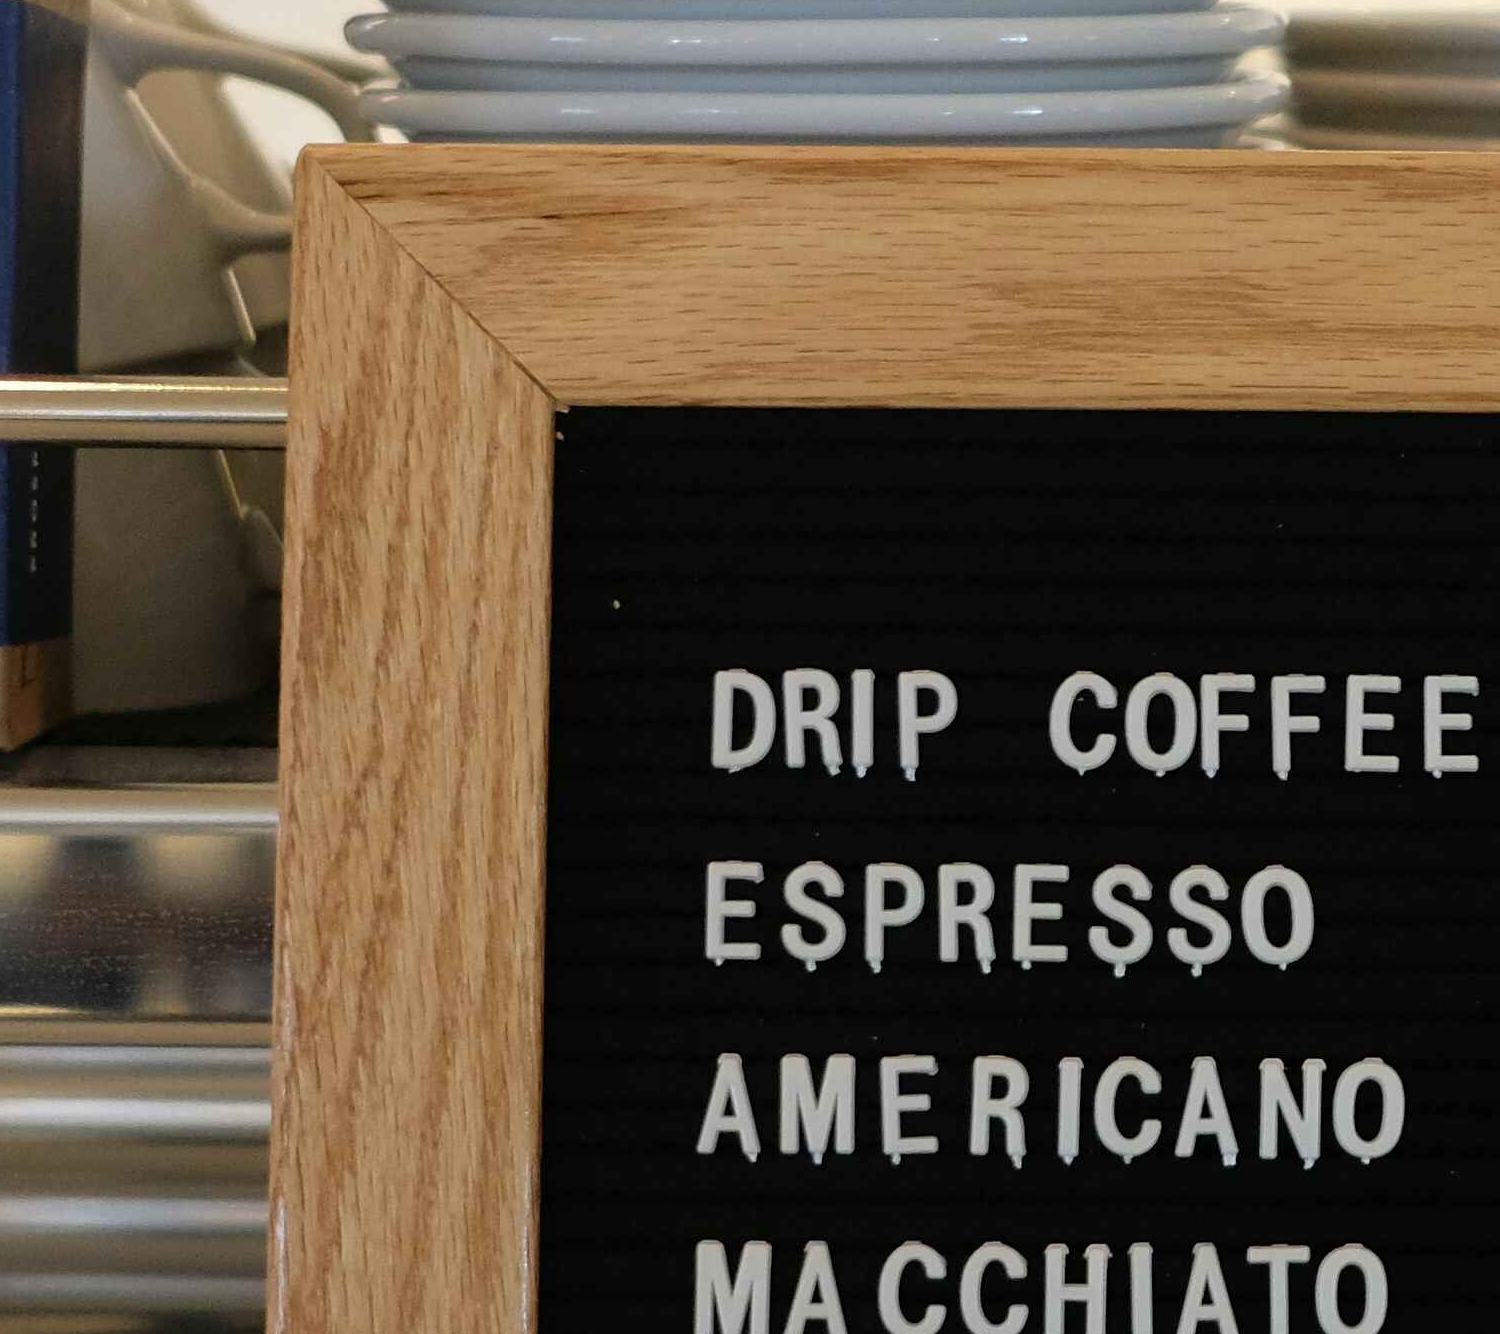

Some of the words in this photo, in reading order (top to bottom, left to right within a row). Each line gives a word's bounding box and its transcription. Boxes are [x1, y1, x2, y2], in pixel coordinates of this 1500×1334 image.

[711, 668, 958, 782] DRIP
[1049, 670, 1479, 781] COFFEE
[705, 860, 1315, 978] ESPRESSO
[696, 1052, 1405, 1170] AMERICANO
